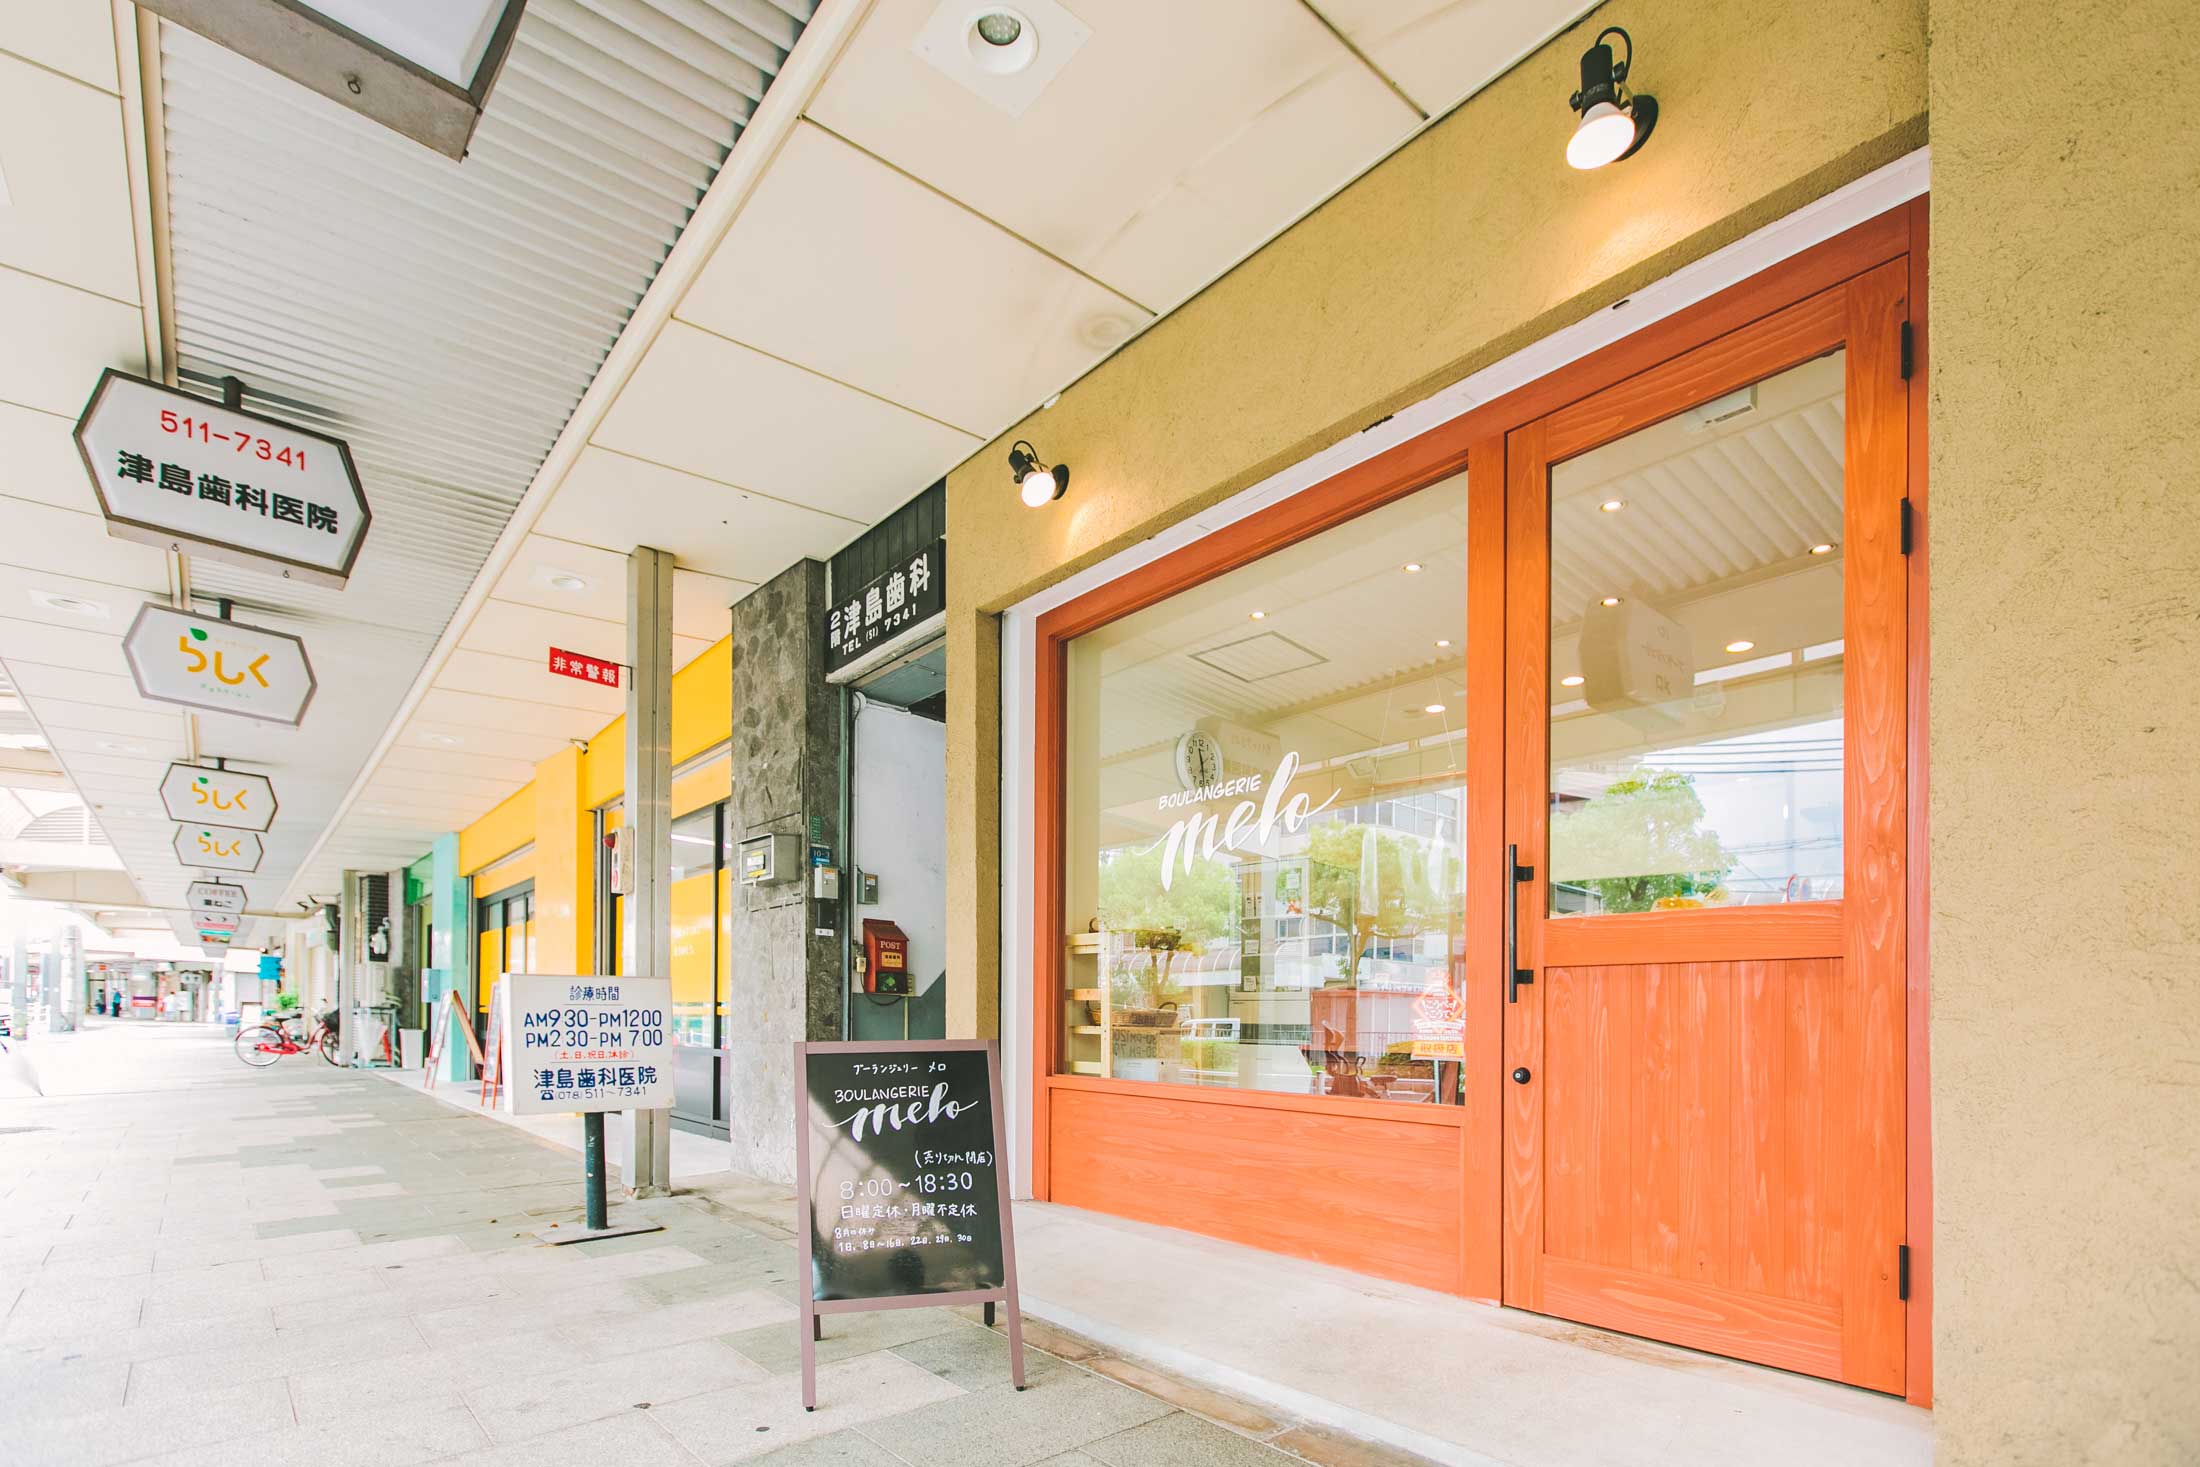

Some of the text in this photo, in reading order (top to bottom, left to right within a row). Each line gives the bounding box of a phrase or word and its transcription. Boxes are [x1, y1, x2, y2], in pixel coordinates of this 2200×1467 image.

[160, 409, 306, 471] 511-7341
[117, 449, 339, 535] 津島歯科医院
[843, 552, 931, 640] 津島歯科
[842, 637, 862, 656] TEL
[884, 602, 917, 632] 7341
[178, 627, 271, 689] らしく
[191, 776, 248, 812] らしく
[1158, 774, 1263, 811] BOULANGERIE
[1137, 751, 1342, 893] melo
[197, 831, 241, 858] らしく
[880, 940, 902, 950] POST
[569, 985, 620, 1001] 診療時間
[534, 1066, 658, 1089] 津島歯科医院
[852, 1061, 947, 1075] ブーランジェリー メロ
[823, 1082, 979, 1142] melo
[834, 1085, 931, 1104] BOULANGERIE
